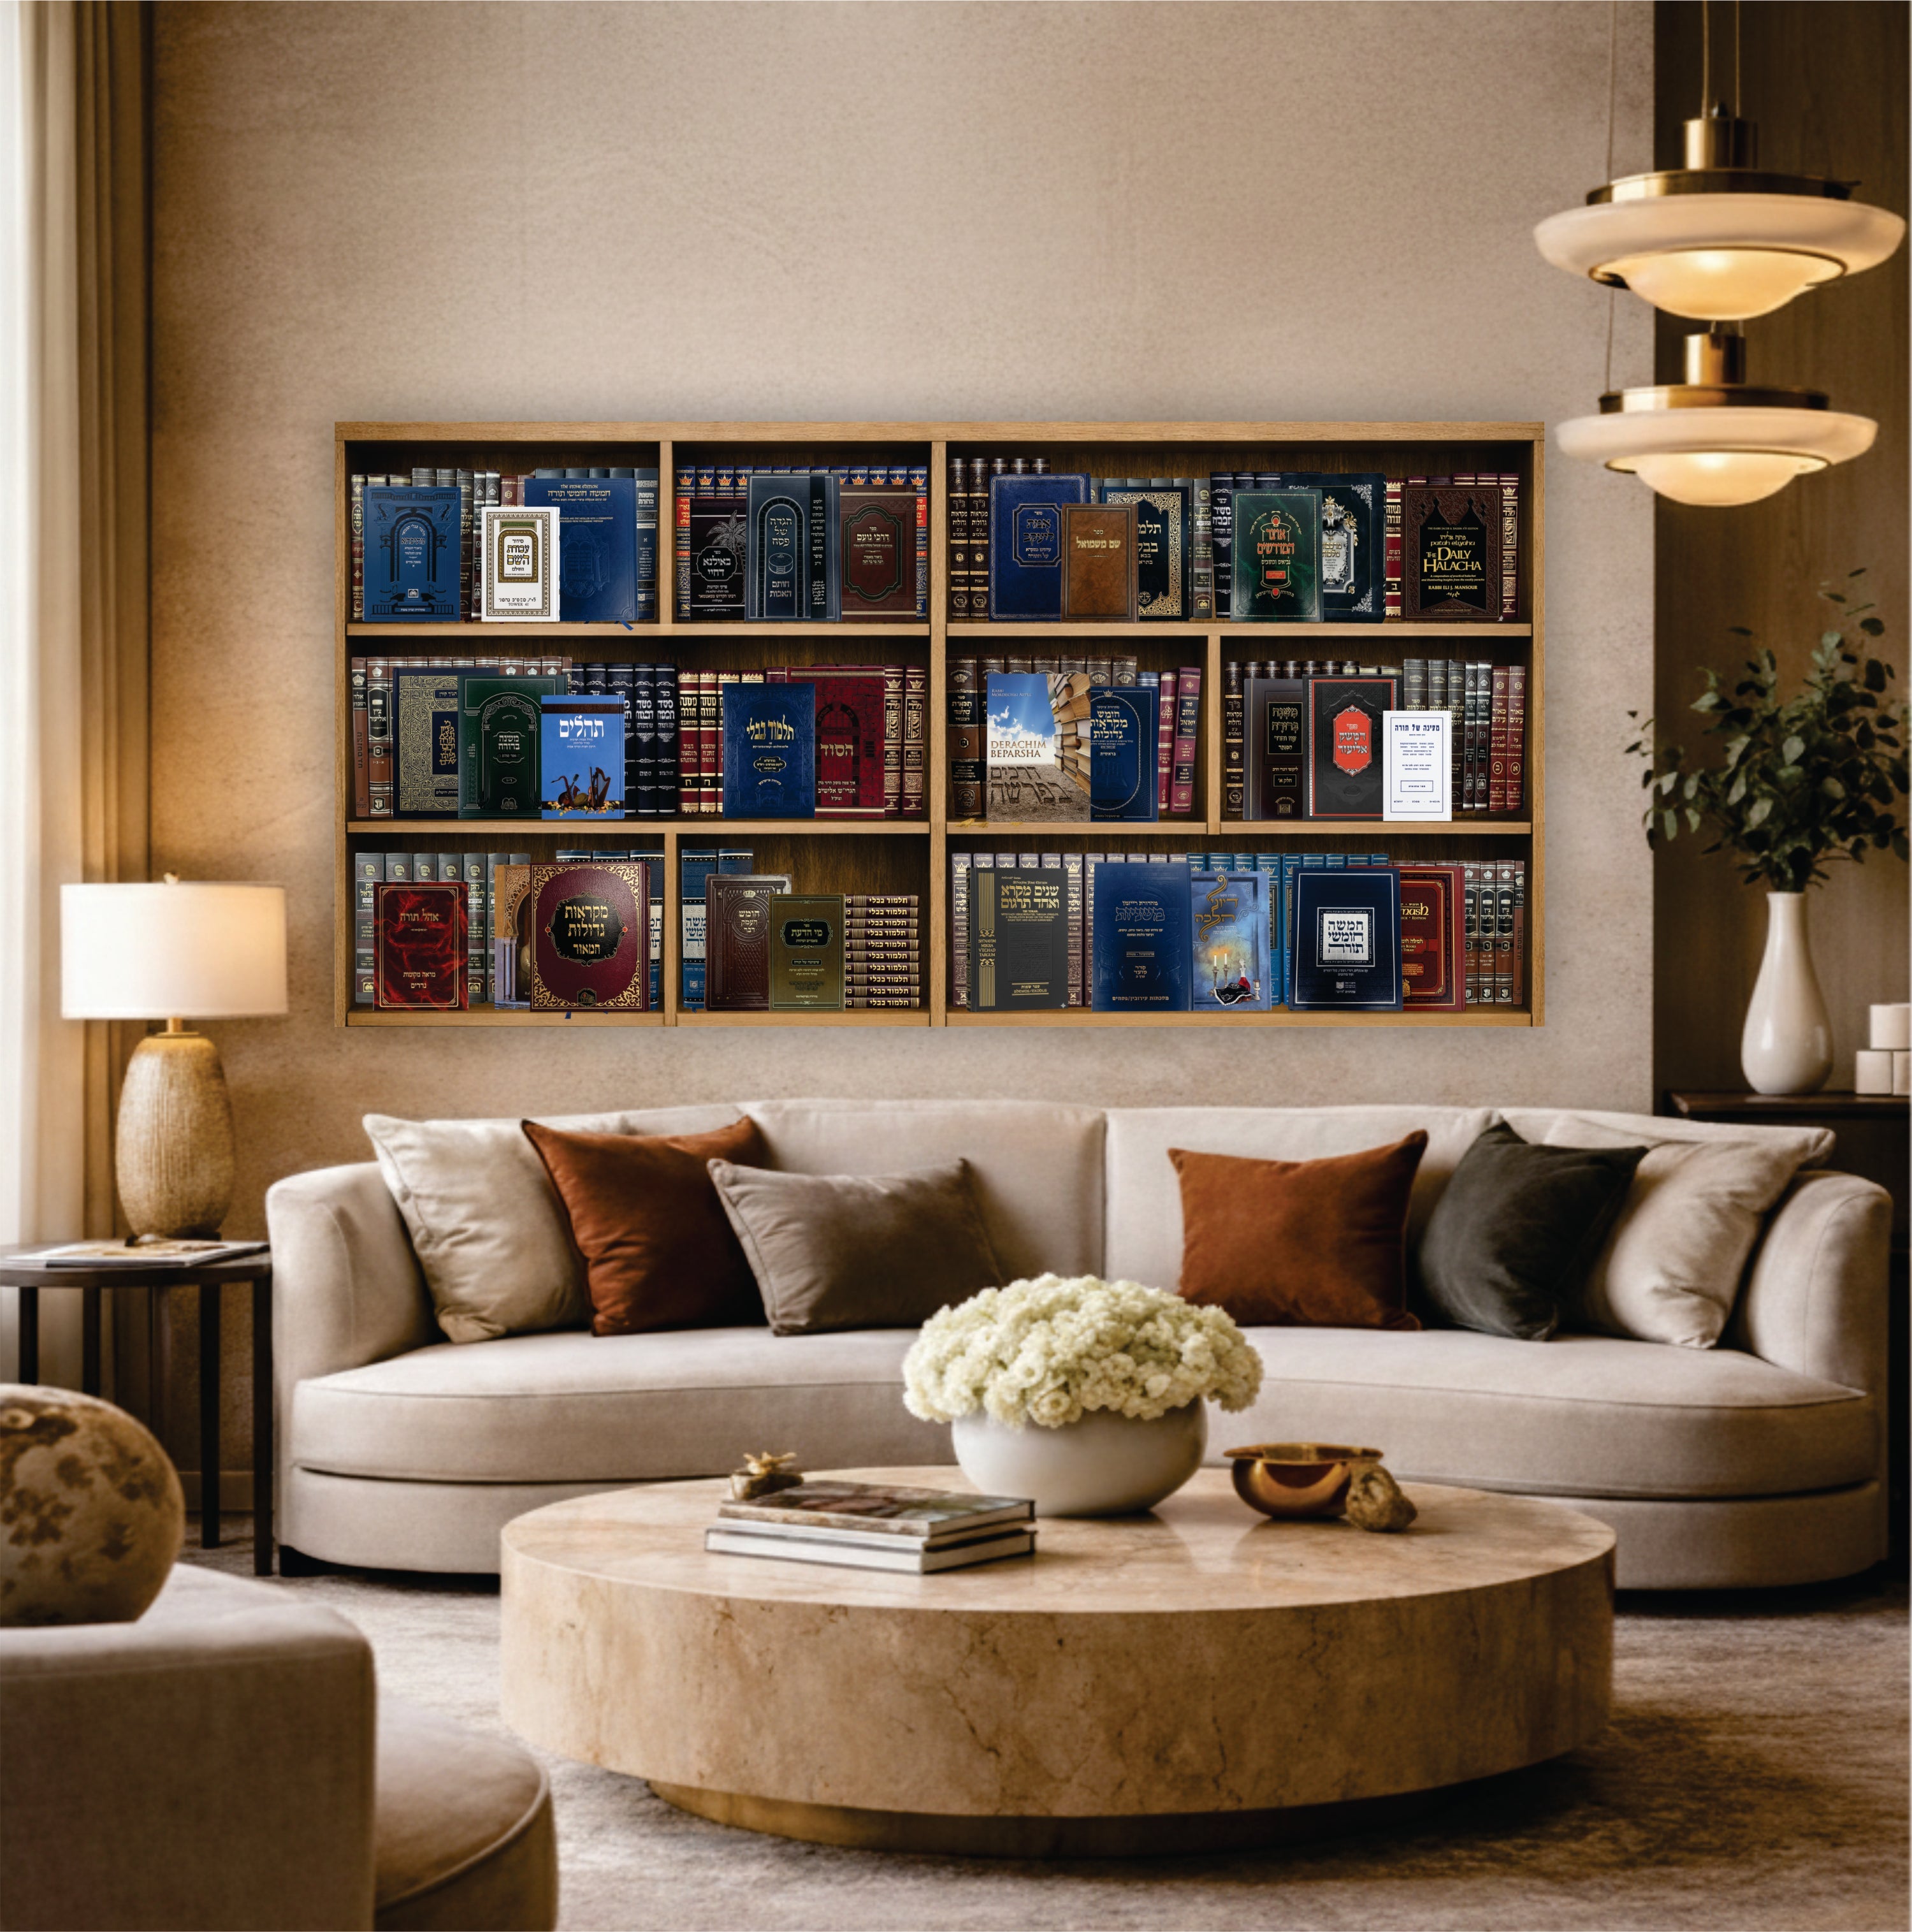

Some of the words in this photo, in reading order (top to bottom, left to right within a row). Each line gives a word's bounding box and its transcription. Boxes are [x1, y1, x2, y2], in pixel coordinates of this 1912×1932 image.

[1027, 519, 1050, 528] אמת
[1138, 520, 1161, 534] תלמ
[774, 527, 788, 535] של
[1266, 528, 1286, 540] אוצר
[772, 537, 790, 546] פסח
[1075, 535, 1107, 549] משמואל
[1109, 539, 1121, 549] שם
[507, 545, 530, 553] עבודת
[1138, 542, 1159, 552] בבל
[1257, 542, 1294, 555] המדרשים
[1437, 547, 1471, 560] DAILY
[507, 554, 529, 565] השם
[703, 555, 731, 566] באילנא
[1424, 559, 1482, 572] HALACHA
[1097, 710, 1120, 718] חומש
[560, 715, 604, 737] תהלים
[746, 717, 765, 740] בבלי
[768, 715, 794, 740] תלמוד
[1090, 718, 1128, 730] מקראות
[1094, 729, 1123, 739] גדולות
[1339, 732, 1366, 743] דמשק
[990, 740, 1047, 748] DERACHIM
[1337, 742, 1368, 755] אליעזר
[820, 743, 853, 757] הסוד
[990, 766, 1041, 780] דרכים
[990, 781, 1073, 805] בפרשה
[1001, 885, 1031, 899] מקרא
[1035, 885, 1059, 896] שנים
[887, 896, 908, 904] תלמוד
[1001, 898, 1031, 908] תרגום
[1034, 898, 1059, 908] ואחד
[400, 912, 419, 922] תורה
[422, 908, 439, 922] אהל
[564, 905, 609, 922] מקראות
[886, 908, 907, 916] תלמוד
[1115, 907, 1165, 922] משניות
[568, 919, 605, 937] גדולות
[886, 919, 906, 927] תלמוד
[1328, 920, 1363, 931] חמשה
[867, 929, 883, 938] בבלי
[885, 929, 906, 937] תלמוד
[1328, 931, 1363, 942] חומשי
[573, 943, 600, 955] המאור
[868, 941, 883, 949] בבלי
[885, 940, 906, 948] תלמוד
[1328, 943, 1363, 954] תורה
[869, 952, 884, 960] בבלי
[887, 952, 907, 960] תלמוד
[870, 964, 885, 972] בבלי
[887, 963, 908, 971] תלמוד
[870, 975, 885, 984] בבלי
[887, 975, 908, 983] תלמוד
[870, 987, 885, 996] בבלי
[887, 987, 908, 995] תלמוד
[870, 999, 885, 1007] בבלי
[887, 998, 909, 1006] תלמוד
